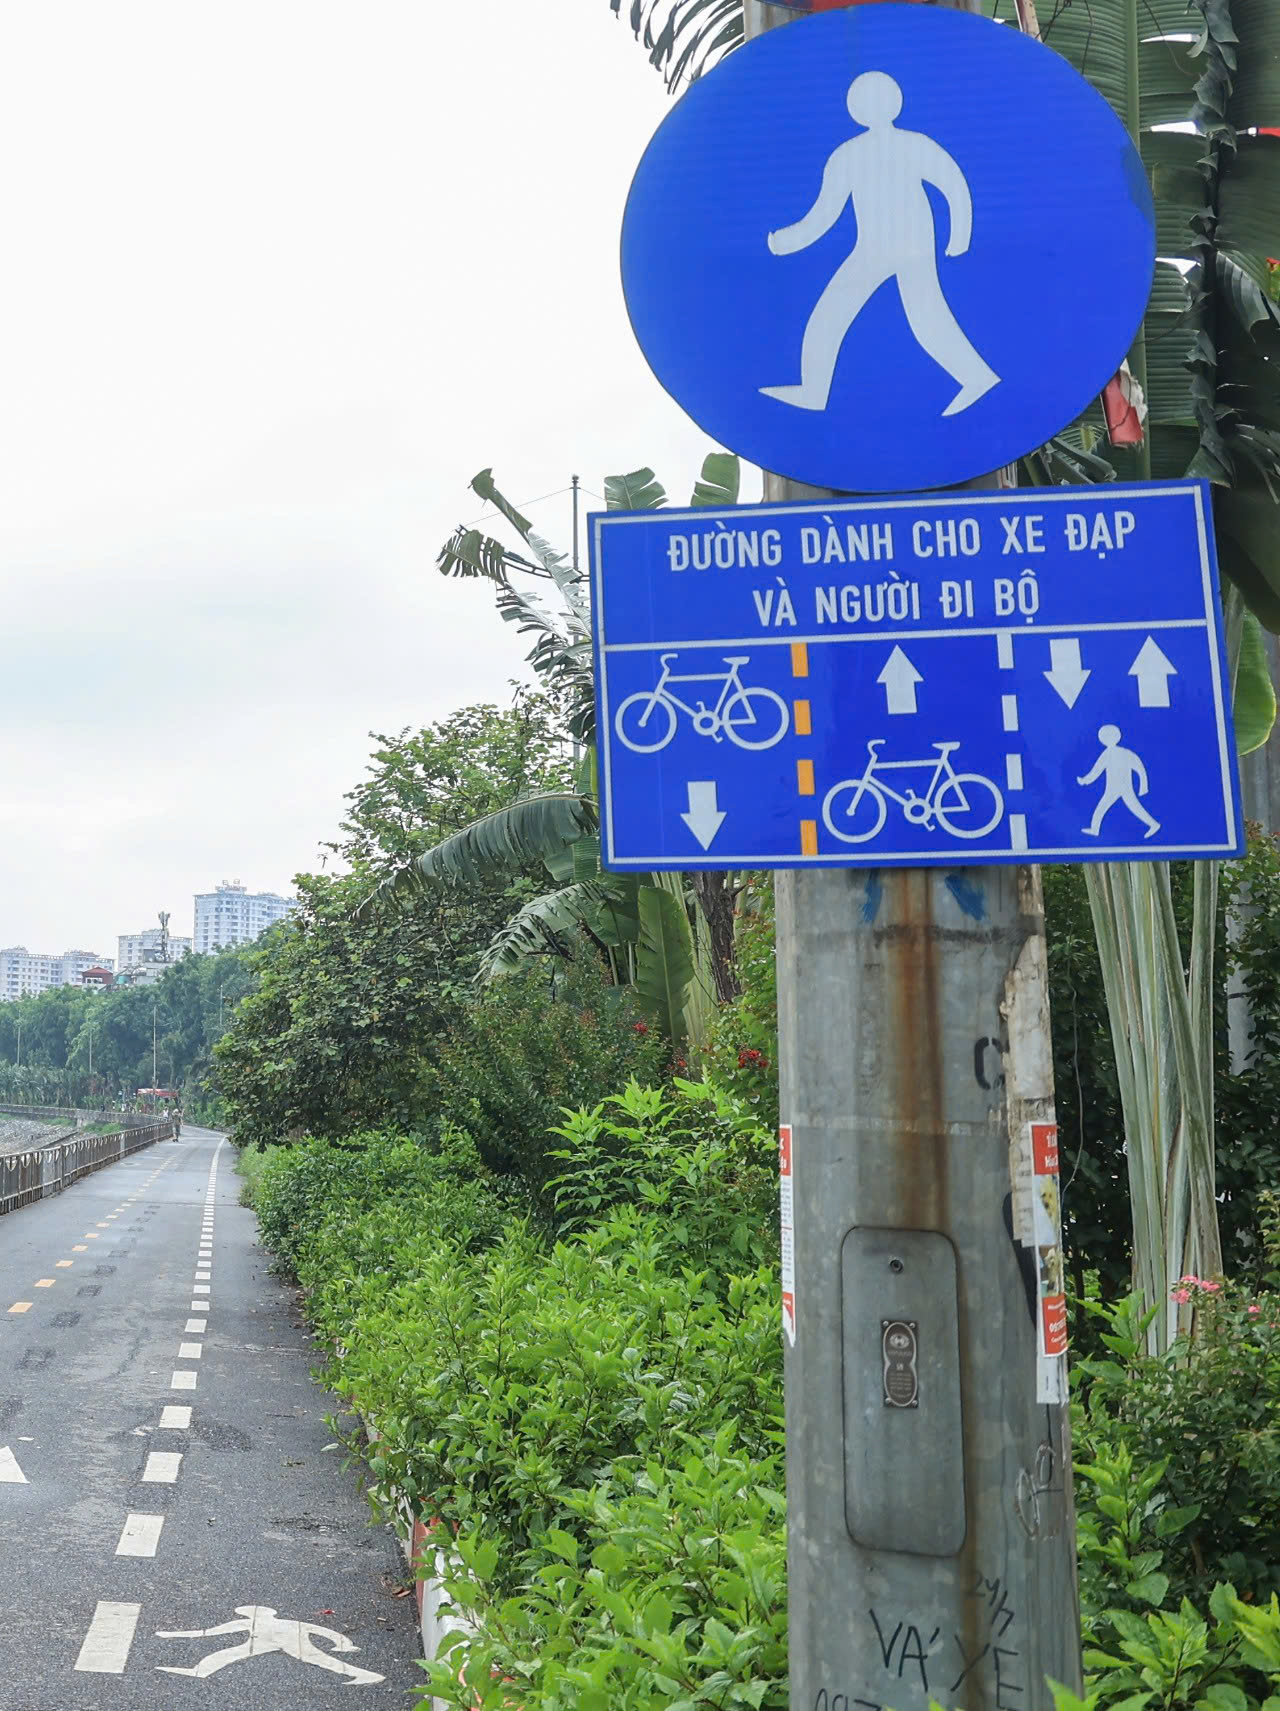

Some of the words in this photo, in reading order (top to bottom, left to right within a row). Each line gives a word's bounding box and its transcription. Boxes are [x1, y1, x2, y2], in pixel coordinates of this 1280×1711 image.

[667, 520, 782, 571] ĐƯỜNG
[801, 515, 893, 564] DÀNH
[913, 519, 980, 558] CHO
[1001, 516, 1045, 554] XE
[1064, 511, 1135, 560] ĐẠP
[753, 577, 797, 627] VÀ
[816, 571, 920, 624] NGƯỜI
[939, 578, 974, 619] ĐI
[995, 570, 1041, 625] BỘ
